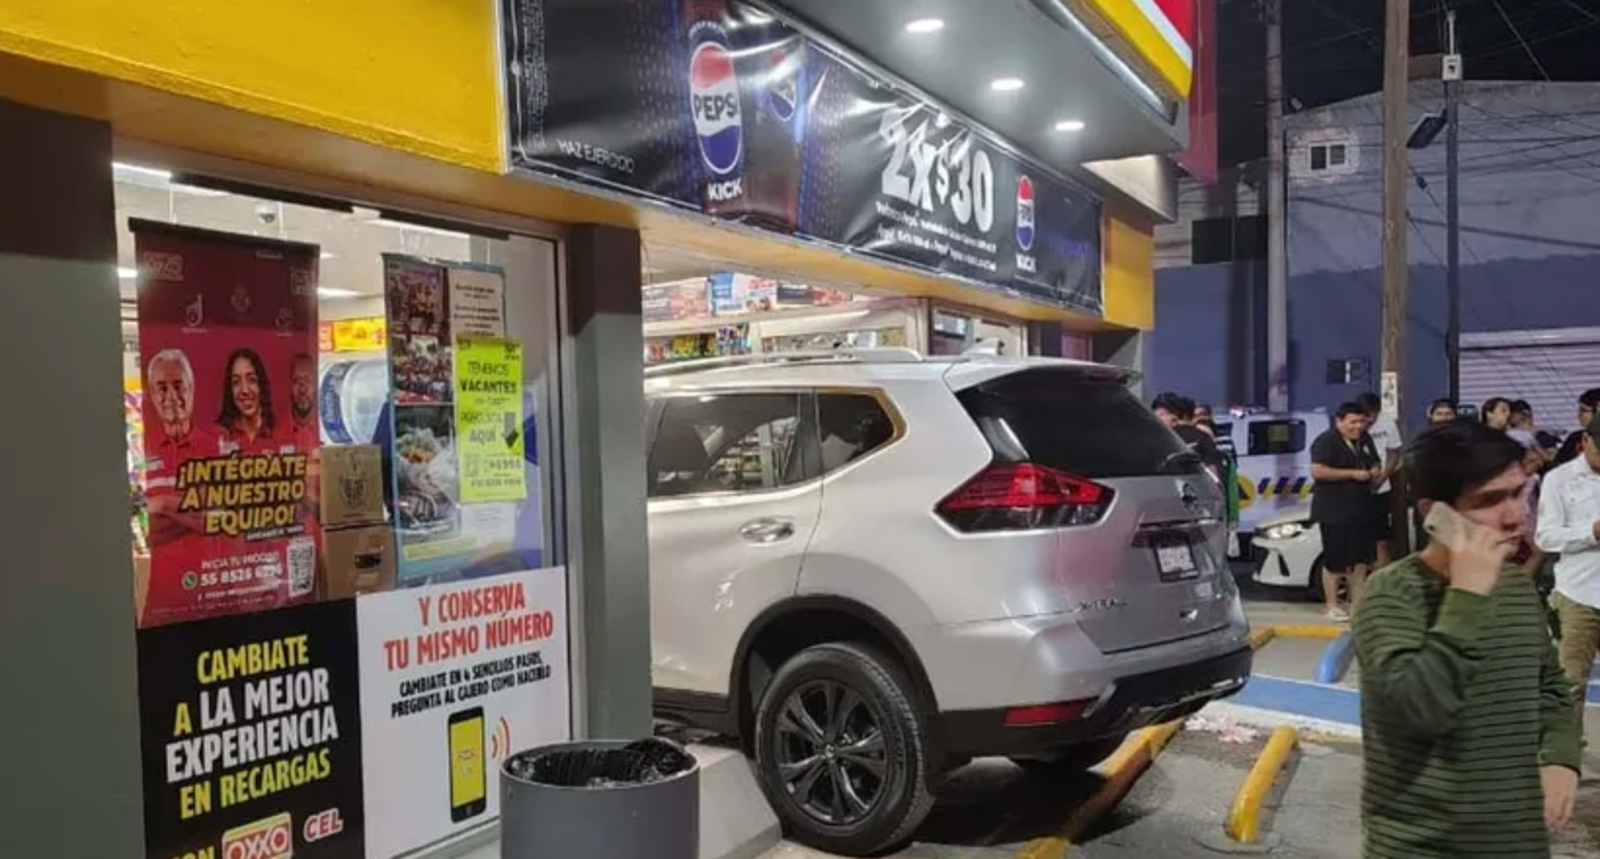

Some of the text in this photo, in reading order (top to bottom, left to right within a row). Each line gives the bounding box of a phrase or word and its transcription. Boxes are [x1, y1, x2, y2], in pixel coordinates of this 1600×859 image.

[707, 179, 742, 201] KICK
[460, 378, 517, 393] VACANTES
[179, 453, 307, 489] ¡INTÉGRATE
[181, 481, 304, 509] A NUESTRO
[205, 505, 297, 535] EQUIPO!
[201, 573, 219, 587] 55
[418, 582, 526, 627] Y CONSERVA
[197, 634, 309, 683] CAMBIATE
[384, 611, 553, 671] TU MISMO NÚMERO
[400, 671, 447, 698] CAMBIATE
[450, 669, 462, 686] EN
[472, 657, 514, 680] SENCILLOS
[173, 667, 330, 737] A LA MEJOR
[391, 694, 441, 719] PREGUNTA
[444, 690, 456, 706] AL
[458, 681, 489, 702] CAJERO
[166, 706, 339, 783] EXPERIENCIA
[180, 748, 331, 819] EN RECARGAS
[224, 808, 344, 859] OXXO CEL
